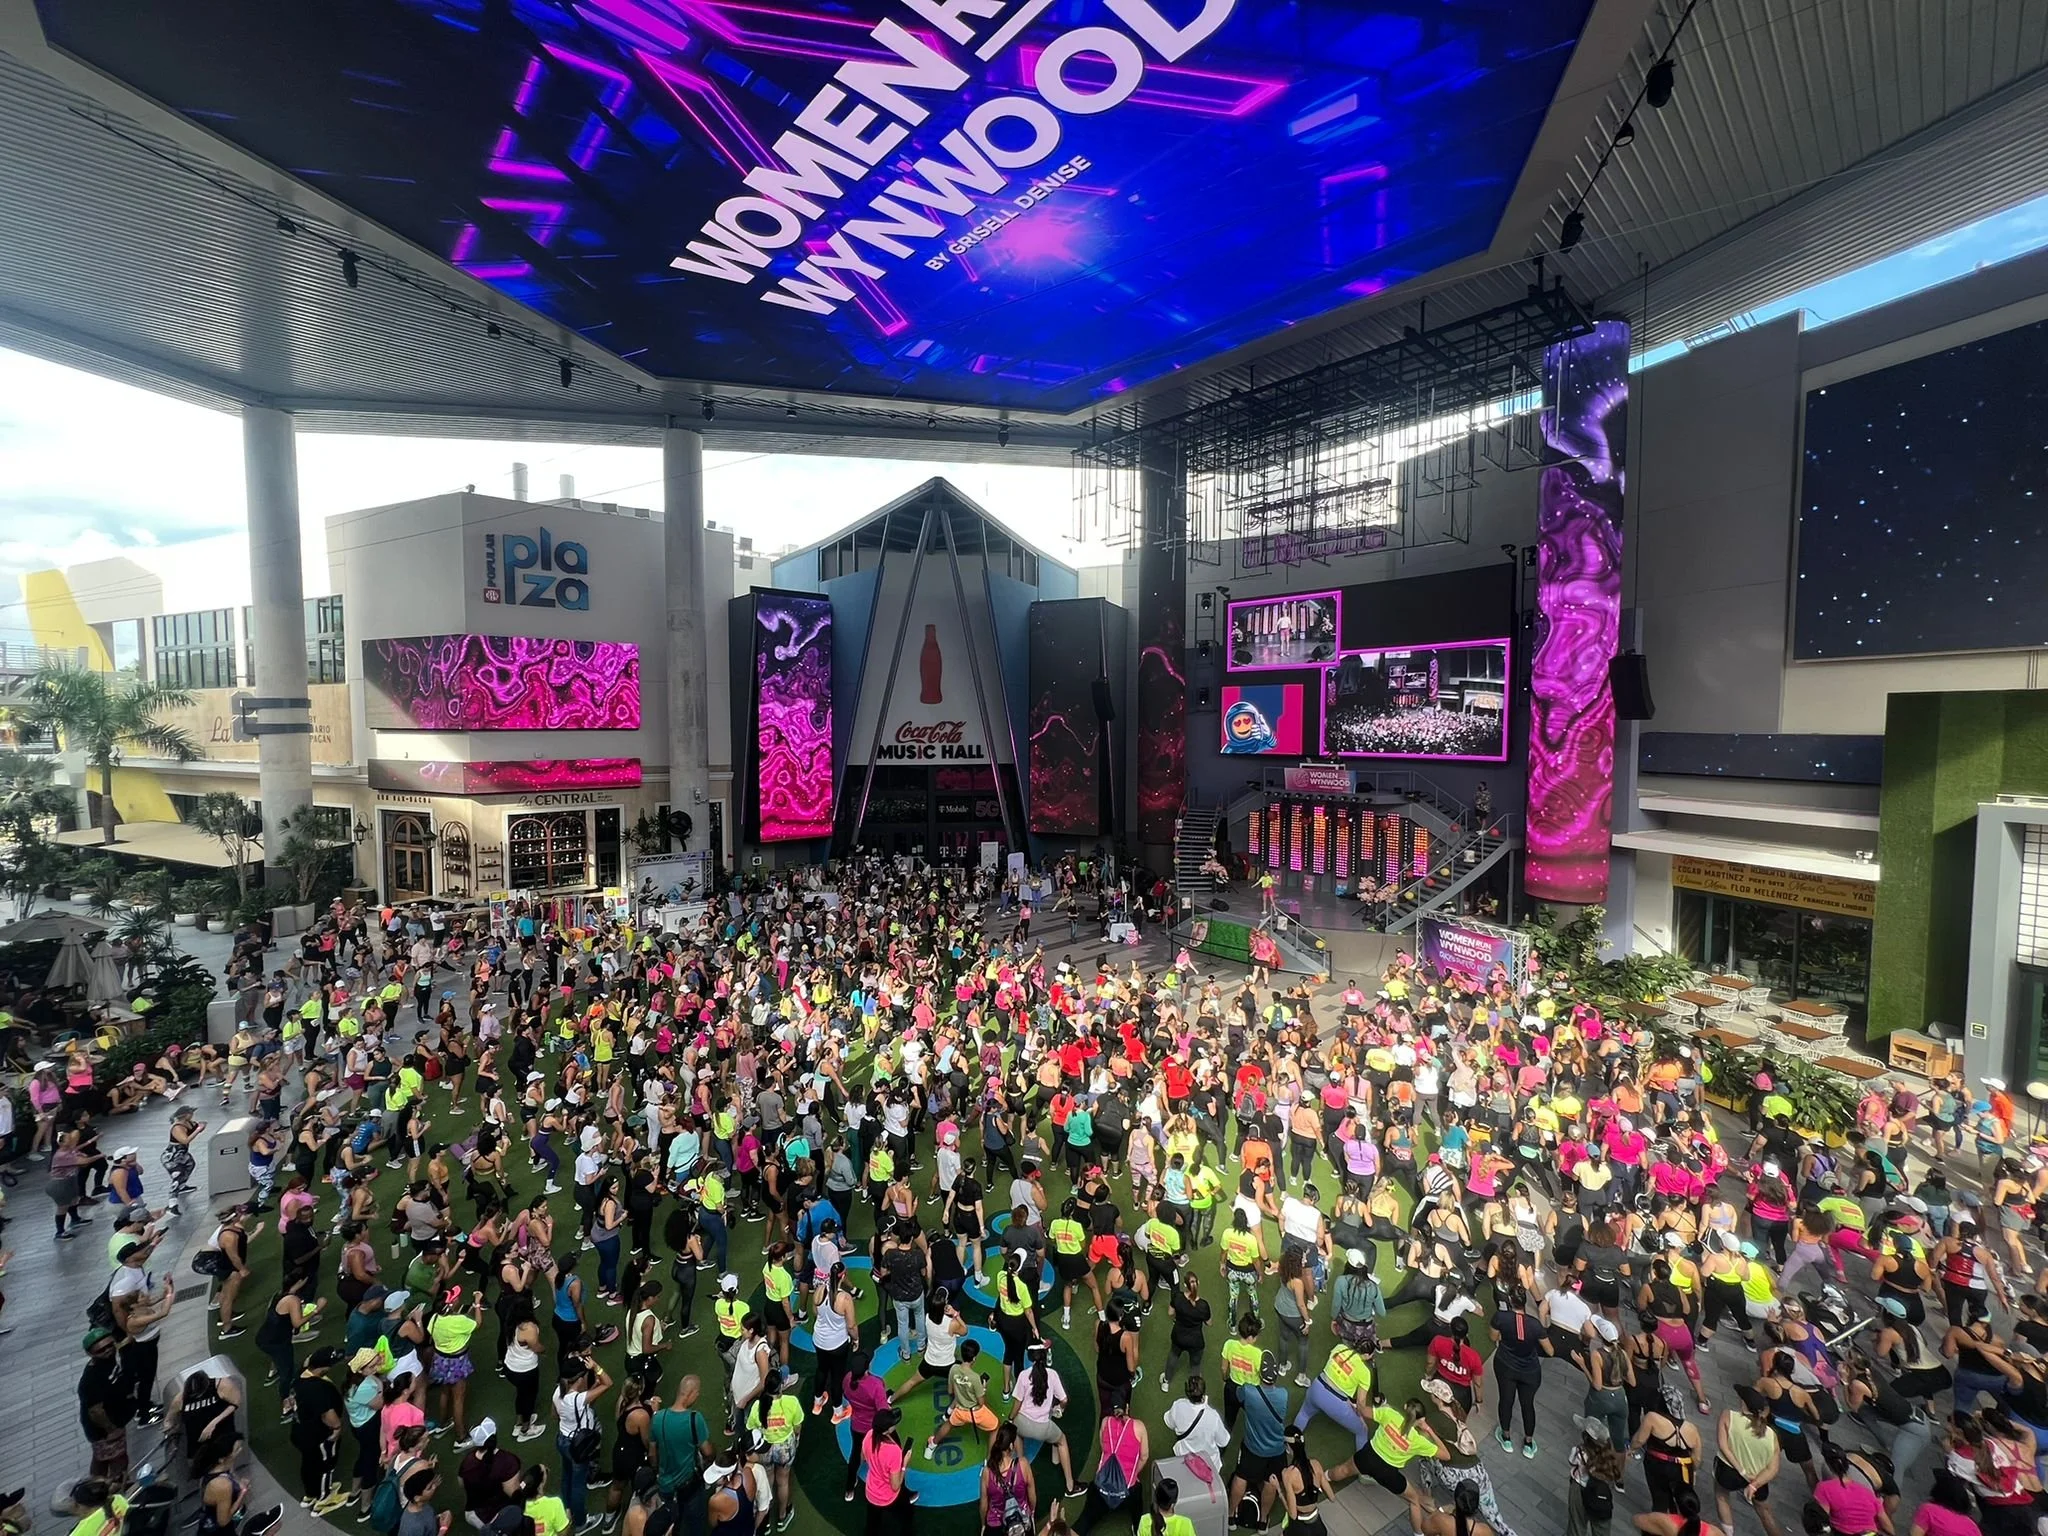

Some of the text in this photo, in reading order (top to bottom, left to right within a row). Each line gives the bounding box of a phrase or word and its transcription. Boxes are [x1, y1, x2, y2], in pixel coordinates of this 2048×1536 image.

[670, 16, 968, 284] WOMEN
[924, 155, 1092, 271] BY GRISELL DENISE
[486, 534, 497, 588] POPULAR
[210, 716, 231, 743] La
[896, 721, 967, 744] Coca-Cola
[877, 744, 985, 760] MUSIC HALL
[1309, 771, 1339, 779] WOMEN
[1309, 778, 1351, 787] WYNWOOD
[534, 792, 597, 806] CENTRAL
[1677, 864, 1702, 875] EDGAR
[1731, 883, 1751, 894] FLOR
[1439, 929, 1492, 951] WOMEN RUN
[1439, 938, 1493, 963] WYNWOOD
